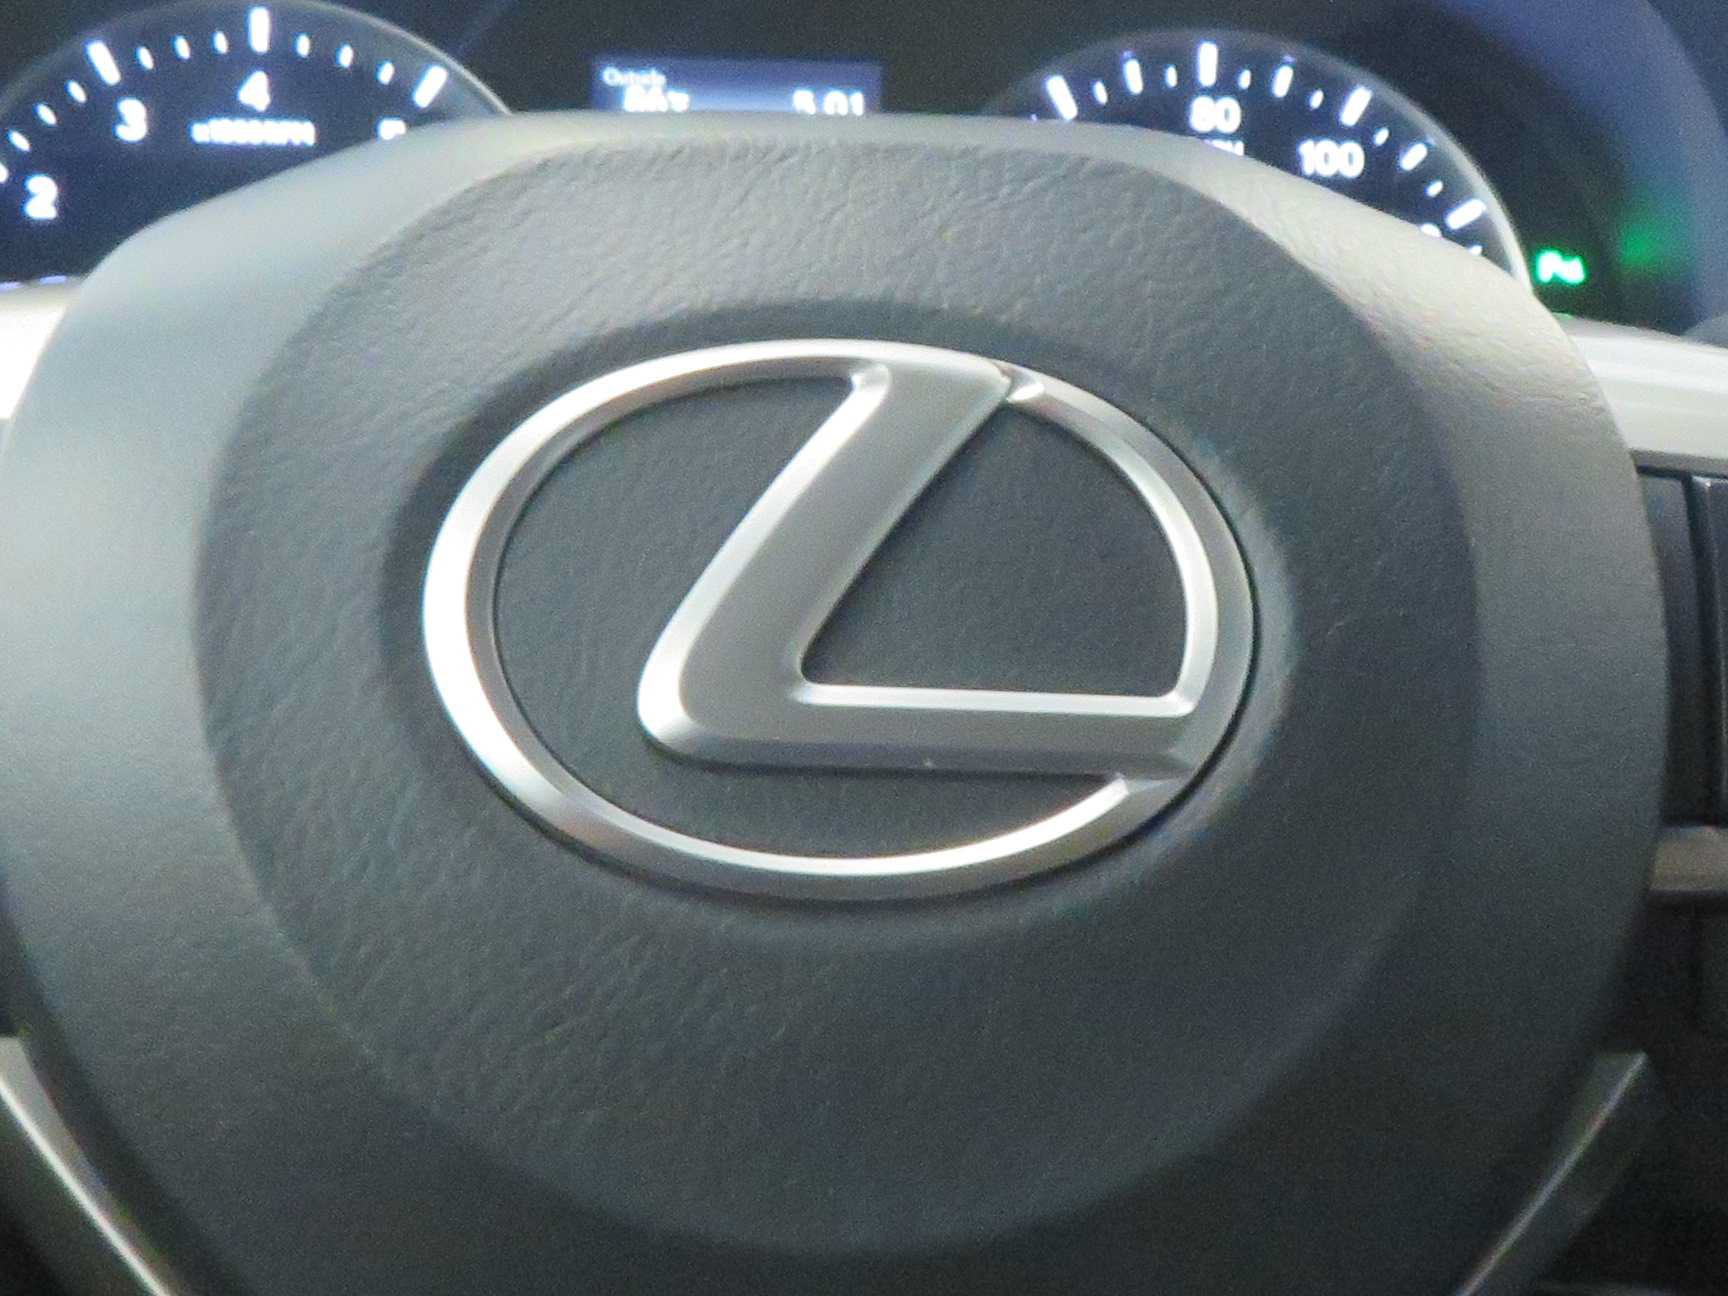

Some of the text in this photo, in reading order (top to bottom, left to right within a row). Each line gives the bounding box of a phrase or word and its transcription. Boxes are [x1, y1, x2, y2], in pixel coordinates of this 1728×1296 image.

[237, 70, 270, 111] 4
[114, 97, 148, 142] 3
[1297, 139, 1364, 178] 100
[23, 174, 59, 220] 2
